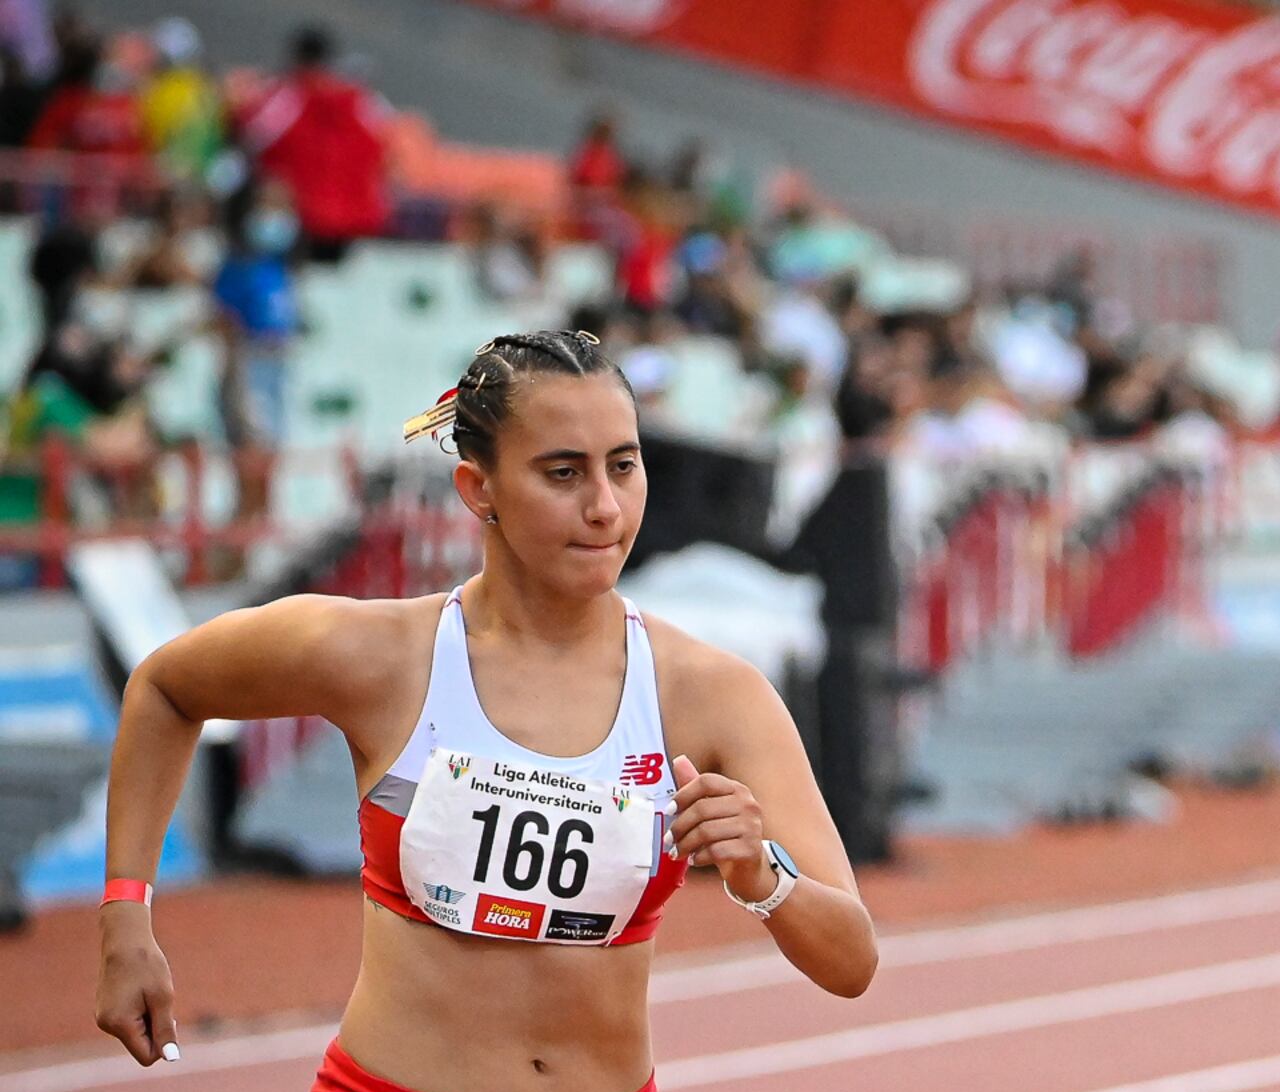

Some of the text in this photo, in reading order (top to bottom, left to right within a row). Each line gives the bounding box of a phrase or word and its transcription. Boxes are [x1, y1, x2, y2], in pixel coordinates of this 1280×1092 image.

[493, 763, 587, 793] Liga Atletica
[470, 777, 603, 815] Interuniversitaria
[472, 804, 594, 899] 166
[424, 901, 460, 917] SEGUROS
[484, 912, 530, 929] HORA
[490, 903, 532, 918] Primera
